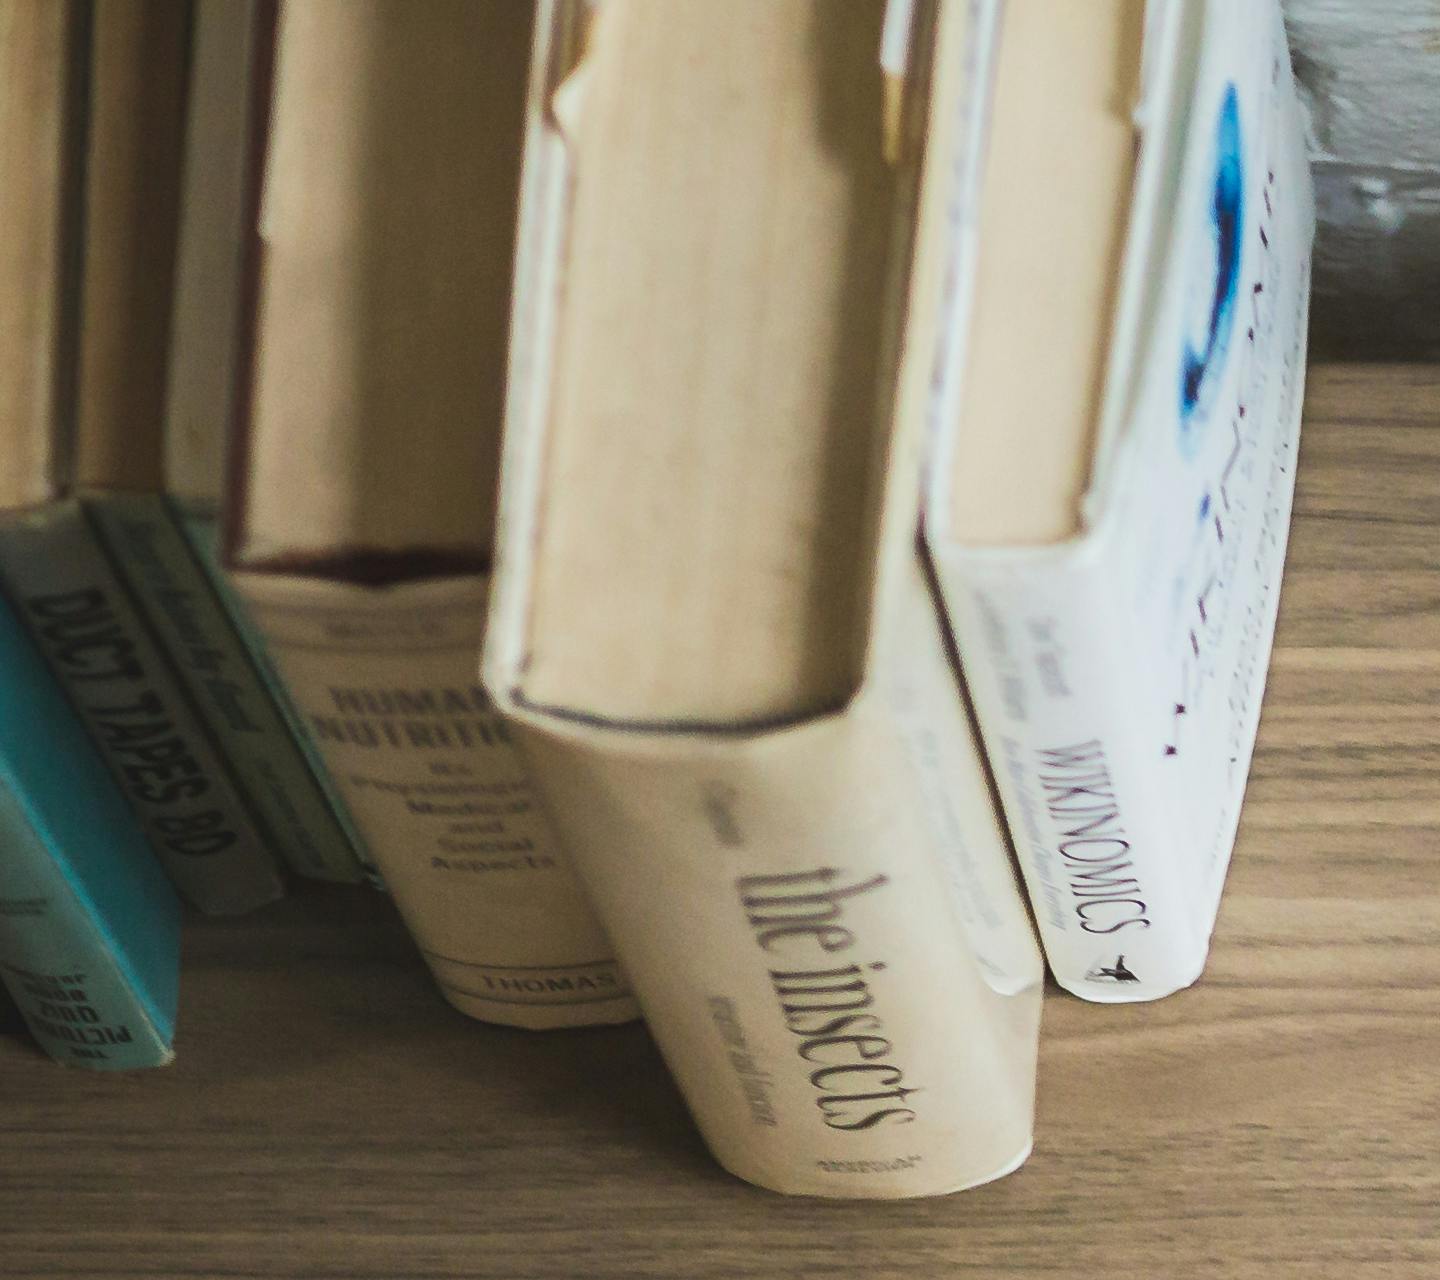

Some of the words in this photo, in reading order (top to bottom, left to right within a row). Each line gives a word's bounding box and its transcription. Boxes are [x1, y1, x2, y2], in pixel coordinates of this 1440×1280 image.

[1032, 736, 1153, 936] WIKINOMICS
[734, 864, 892, 954] the
[482, 970, 618, 996] THOMAS
[768, 960, 924, 1132] insects
